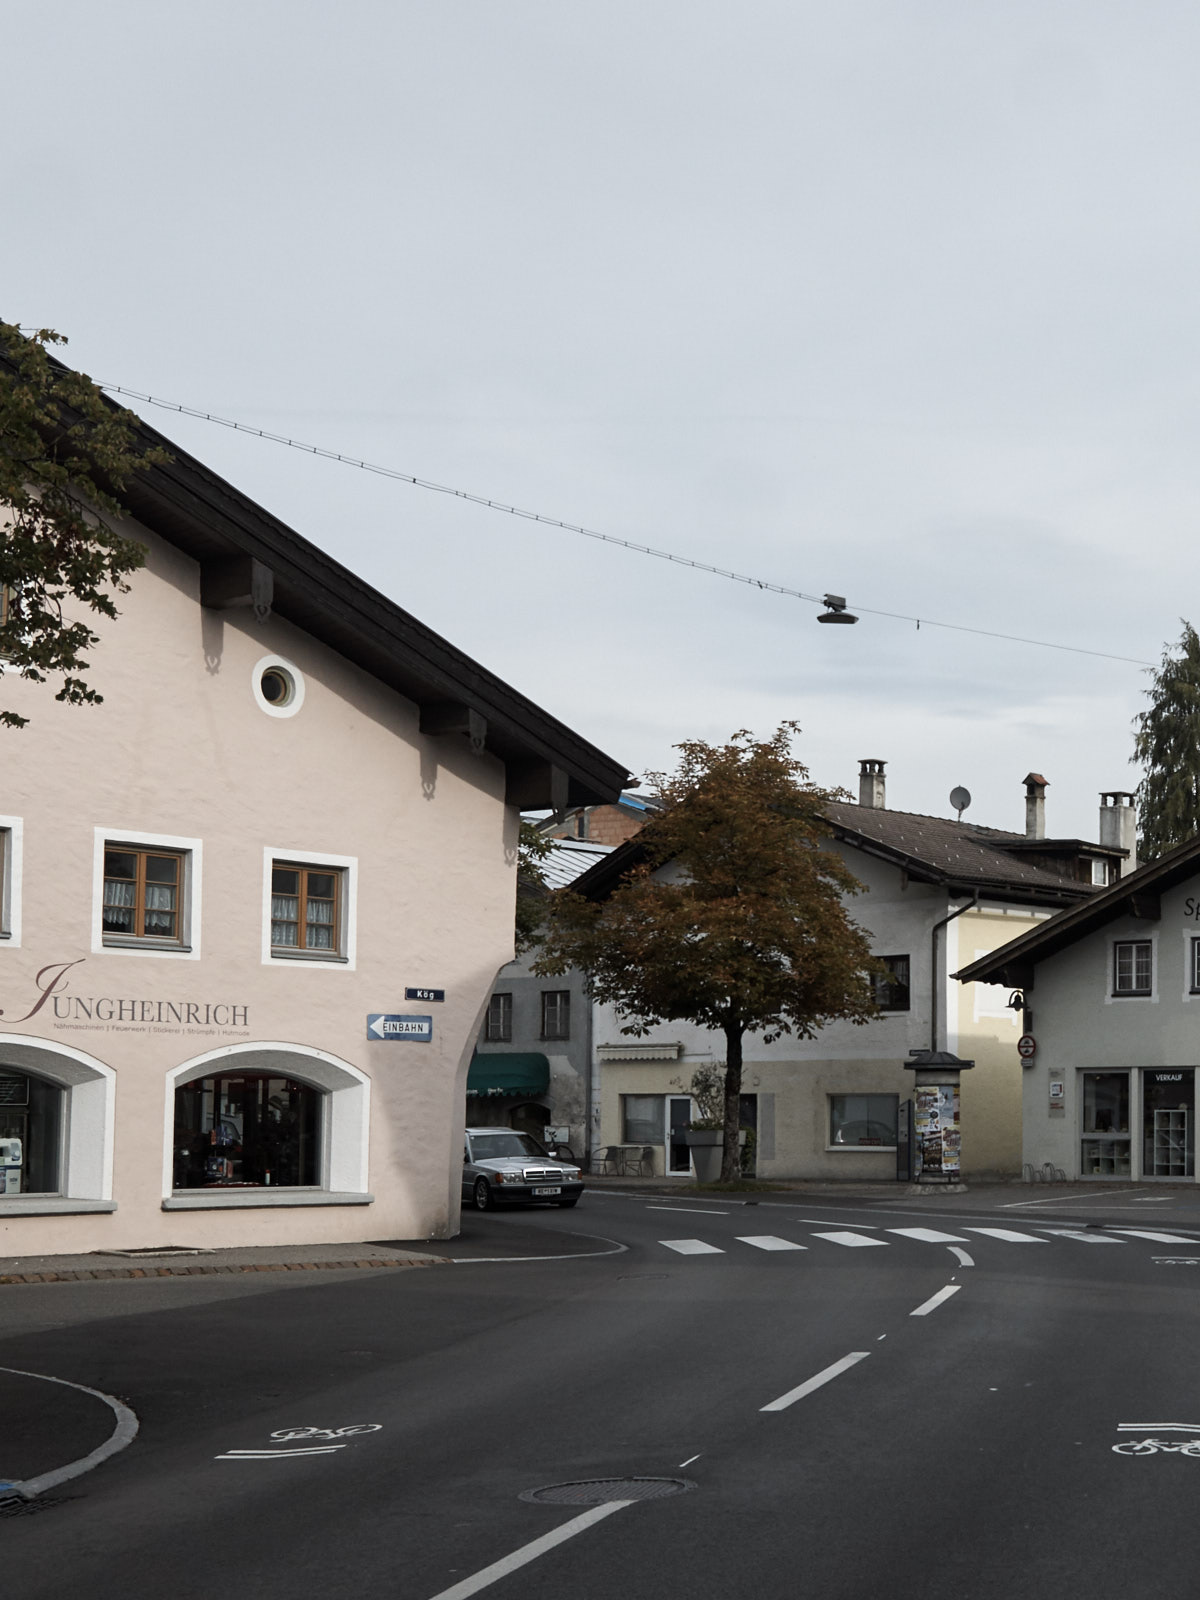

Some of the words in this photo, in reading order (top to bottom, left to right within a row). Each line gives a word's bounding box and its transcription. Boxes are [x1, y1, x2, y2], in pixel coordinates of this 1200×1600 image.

[417, 989, 435, 1001] Kög
[53, 1022, 105, 1032] Nähmaschinen
[112, 1025, 146, 1033] Feuerwerk
[153, 1026, 180, 1034] Stickerei
[187, 1028, 215, 1036] Strümpfe
[222, 1029, 250, 1037] Hutmode
[383, 1021, 424, 1033] EINBAHN
[1155, 1073, 1183, 1081] VERKAUF
